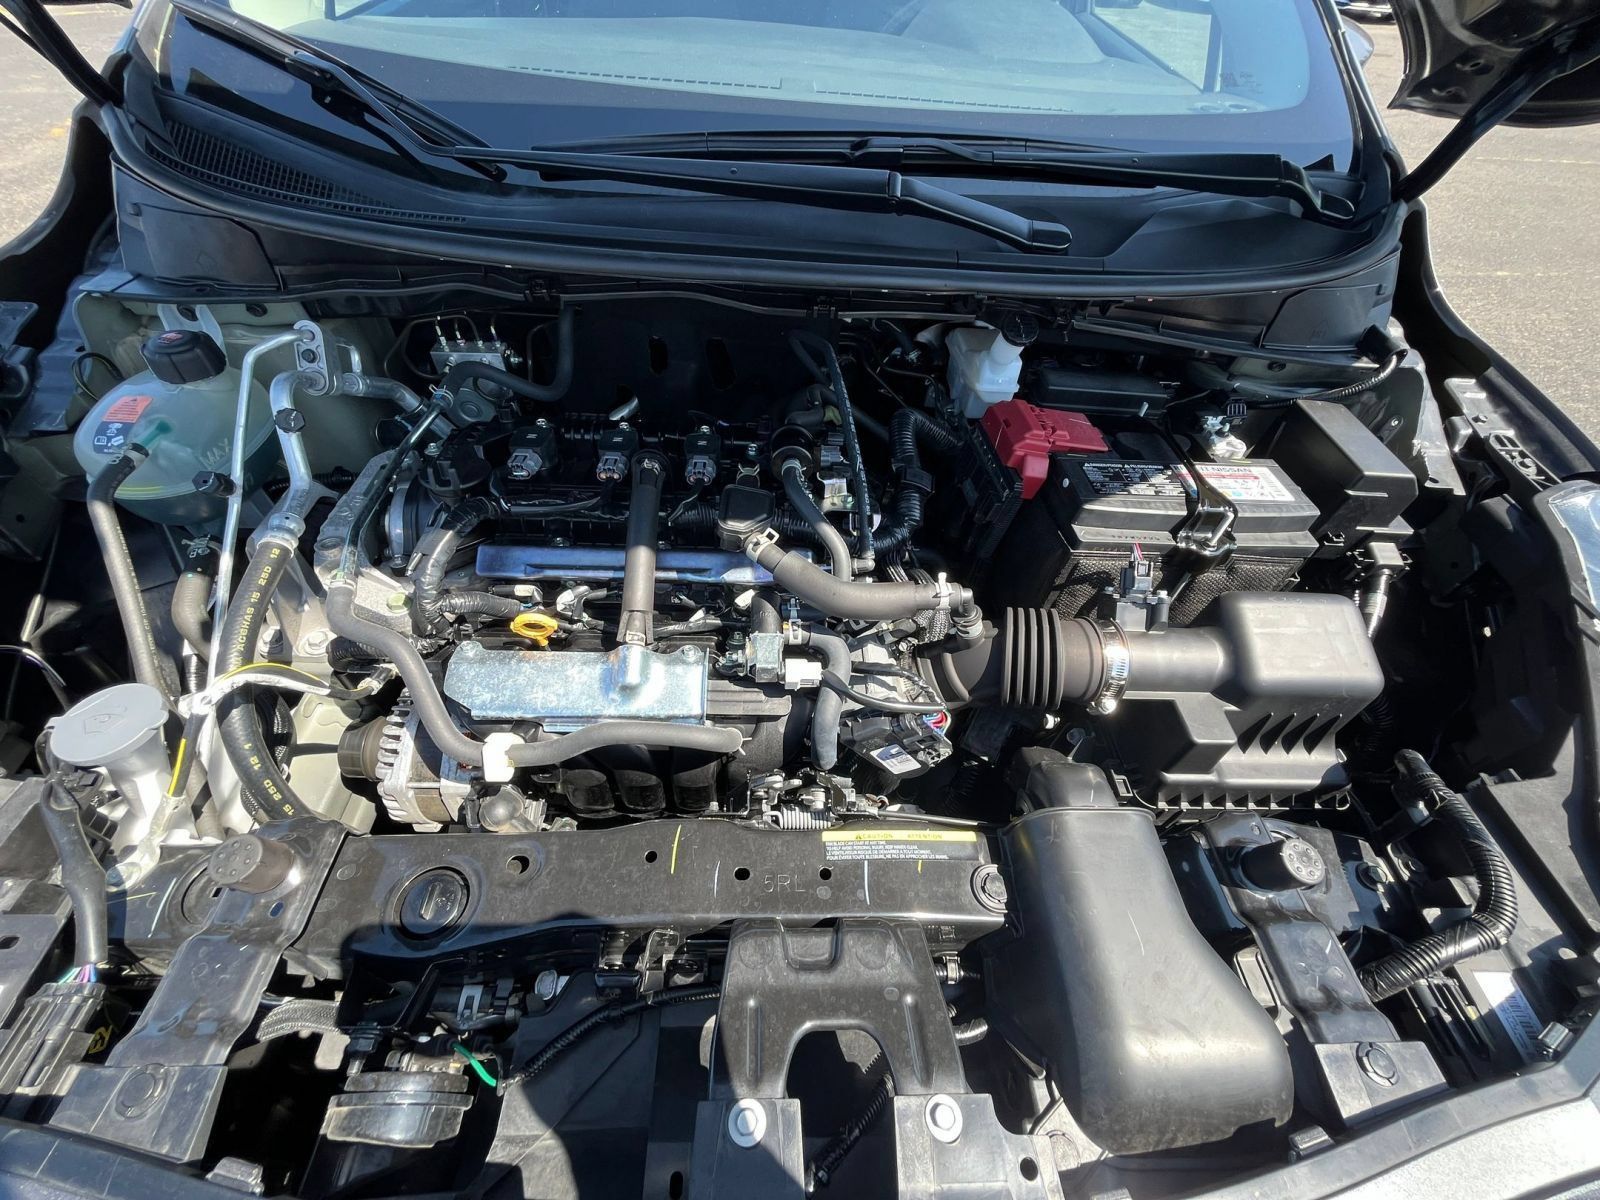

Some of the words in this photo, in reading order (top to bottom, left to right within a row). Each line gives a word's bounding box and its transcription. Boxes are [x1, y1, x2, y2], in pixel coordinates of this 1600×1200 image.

[206, 438, 231, 464] MAX
[250, 591, 261, 603] 15
[270, 548, 281, 559] 12
[250, 755, 262, 770] 12
[282, 803, 295, 816] 15
[764, 874, 806, 893] 5RL
